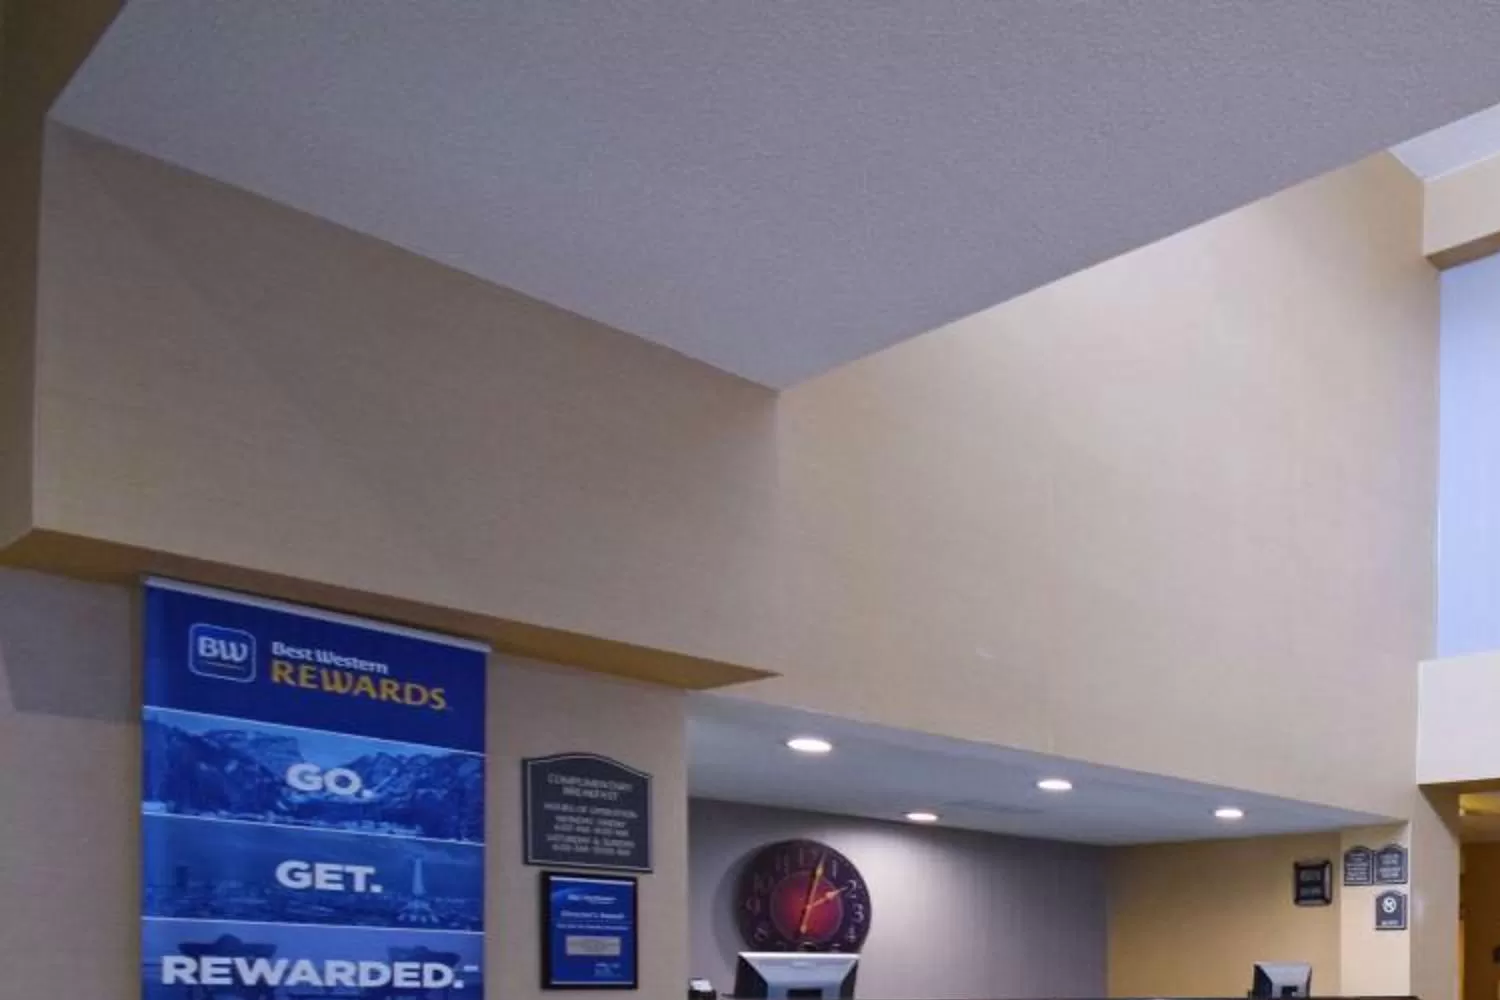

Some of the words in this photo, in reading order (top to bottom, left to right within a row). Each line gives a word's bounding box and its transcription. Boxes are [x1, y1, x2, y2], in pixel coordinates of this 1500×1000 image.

[197, 636, 249, 663] BW
[271, 641, 313, 662] Best
[314, 648, 389, 676] Western
[271, 660, 447, 711] REWARDS
[286, 763, 374, 798] GO.
[276, 860, 383, 893] GET.
